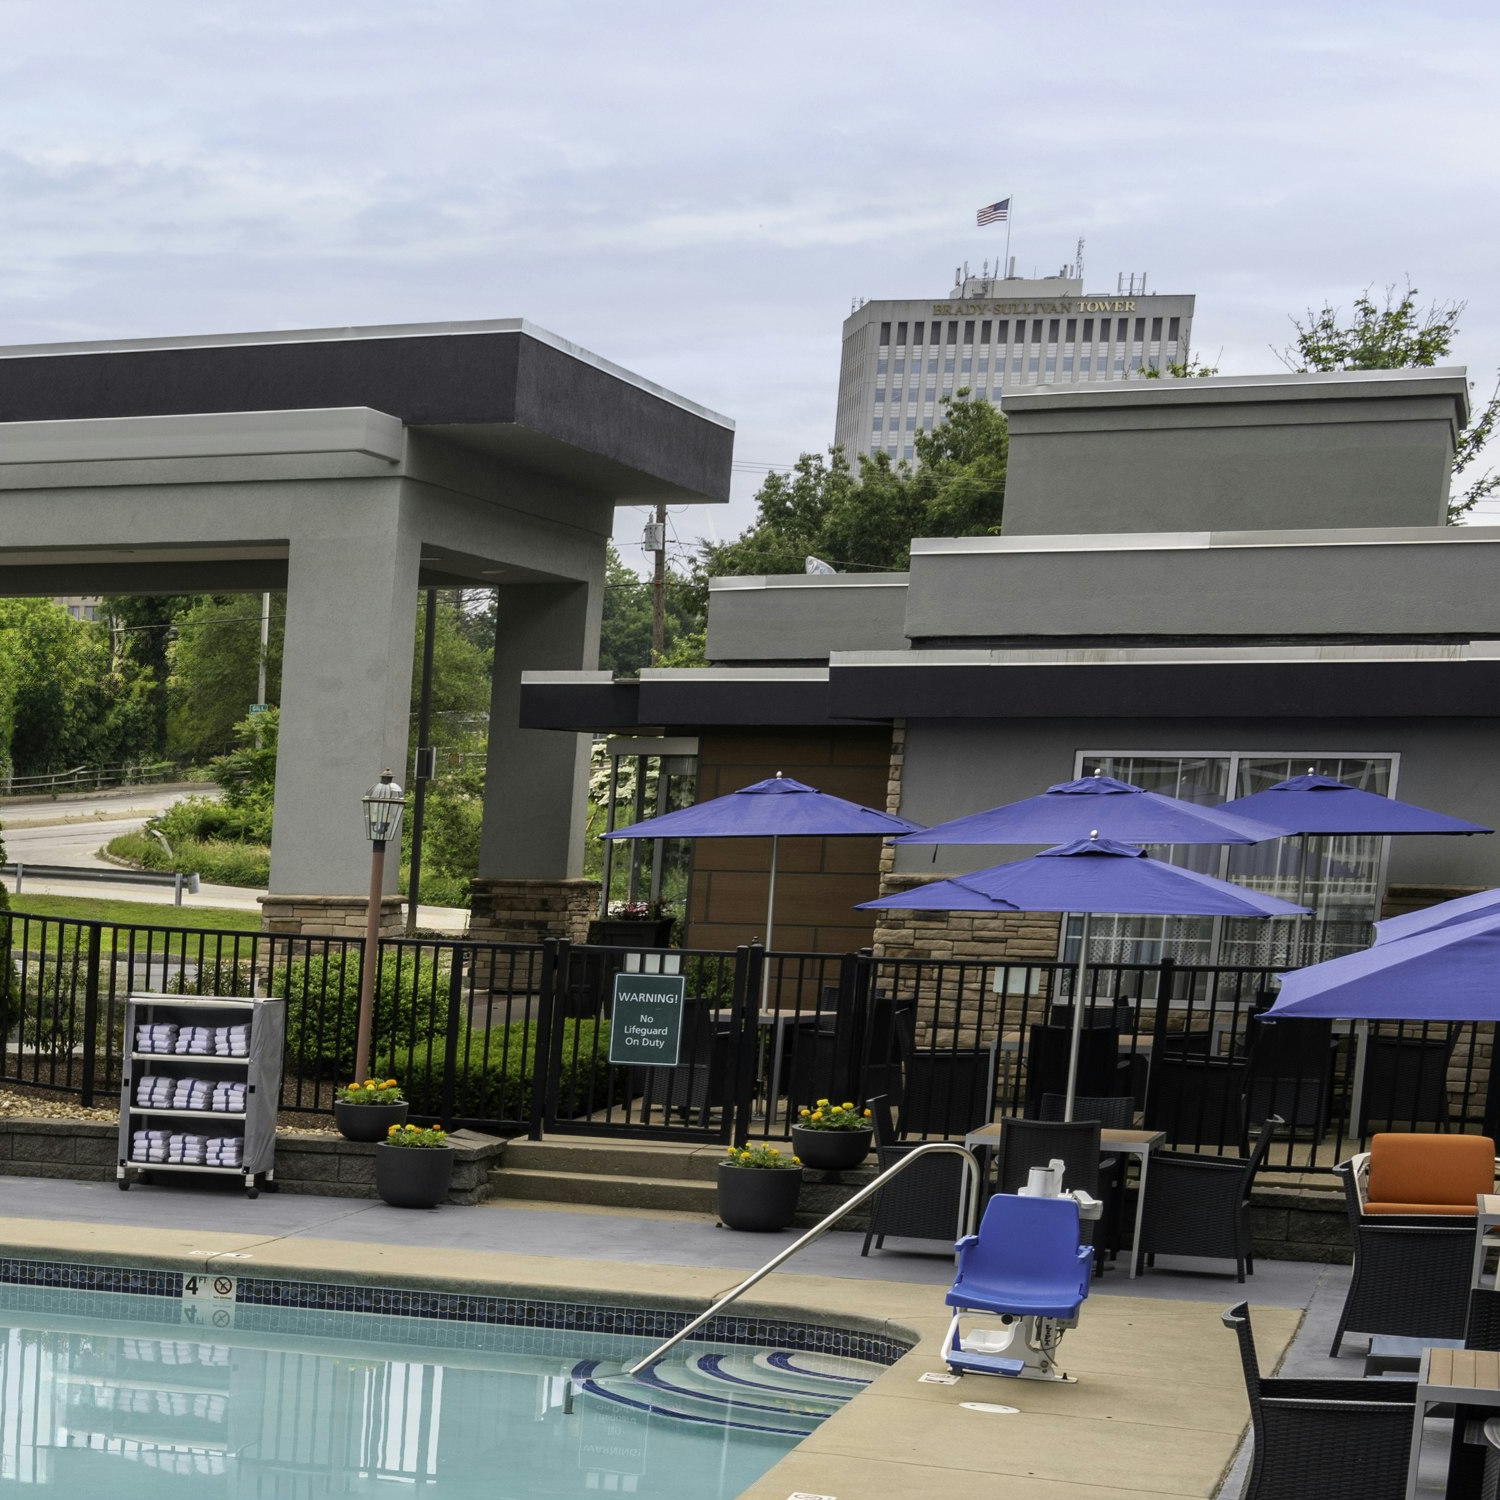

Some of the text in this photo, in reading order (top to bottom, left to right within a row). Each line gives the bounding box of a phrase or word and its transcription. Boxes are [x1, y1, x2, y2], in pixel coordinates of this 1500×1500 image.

[1077, 300, 1136, 313] TOWER
[618, 992, 678, 1004] WARNING!
[640, 1014, 654, 1023] No
[624, 1025, 668, 1036] Lifeguard
[625, 1037, 665, 1049] On Duty
[185, 1275, 198, 1295] 4
